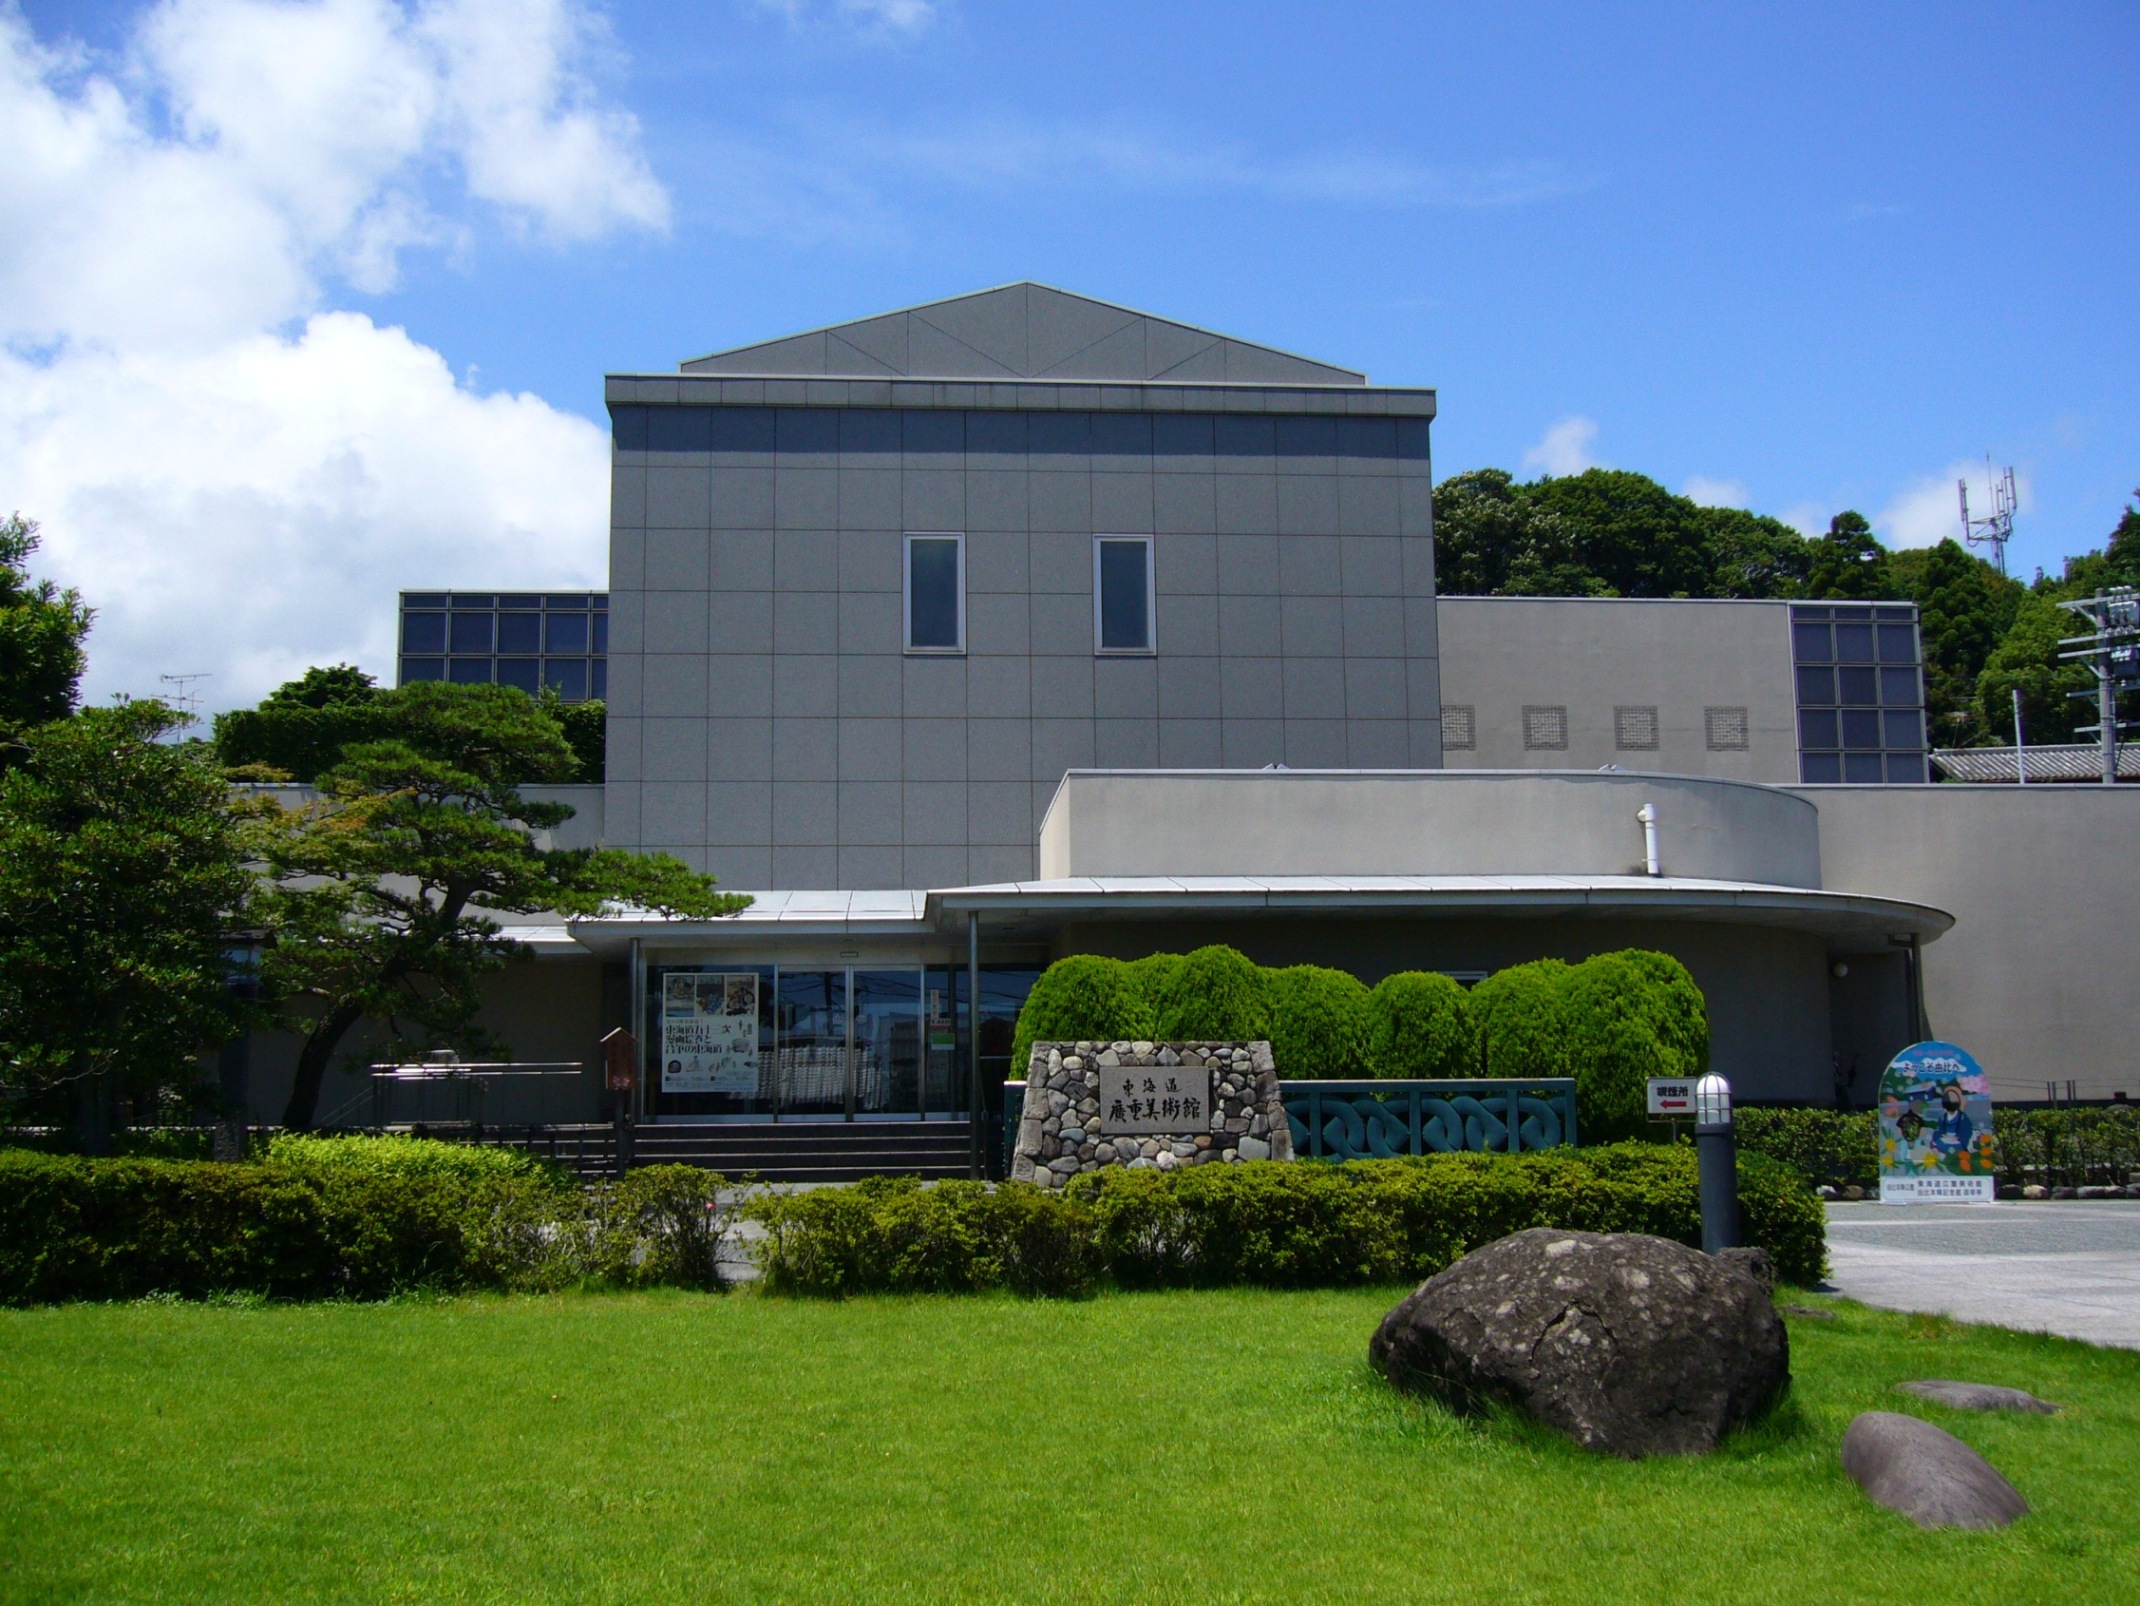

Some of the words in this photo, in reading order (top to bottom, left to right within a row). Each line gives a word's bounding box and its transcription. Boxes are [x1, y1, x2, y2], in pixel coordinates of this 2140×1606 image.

[1903, 1062, 1961, 1073] ようこそ由比へ
[1122, 1077, 1181, 1097] 東海道
[1657, 1086, 1688, 1097] 喫煙所
[1109, 1097, 1202, 1123] 廣重美術館
[1917, 1180, 1982, 1188] 東海道広重美術館
